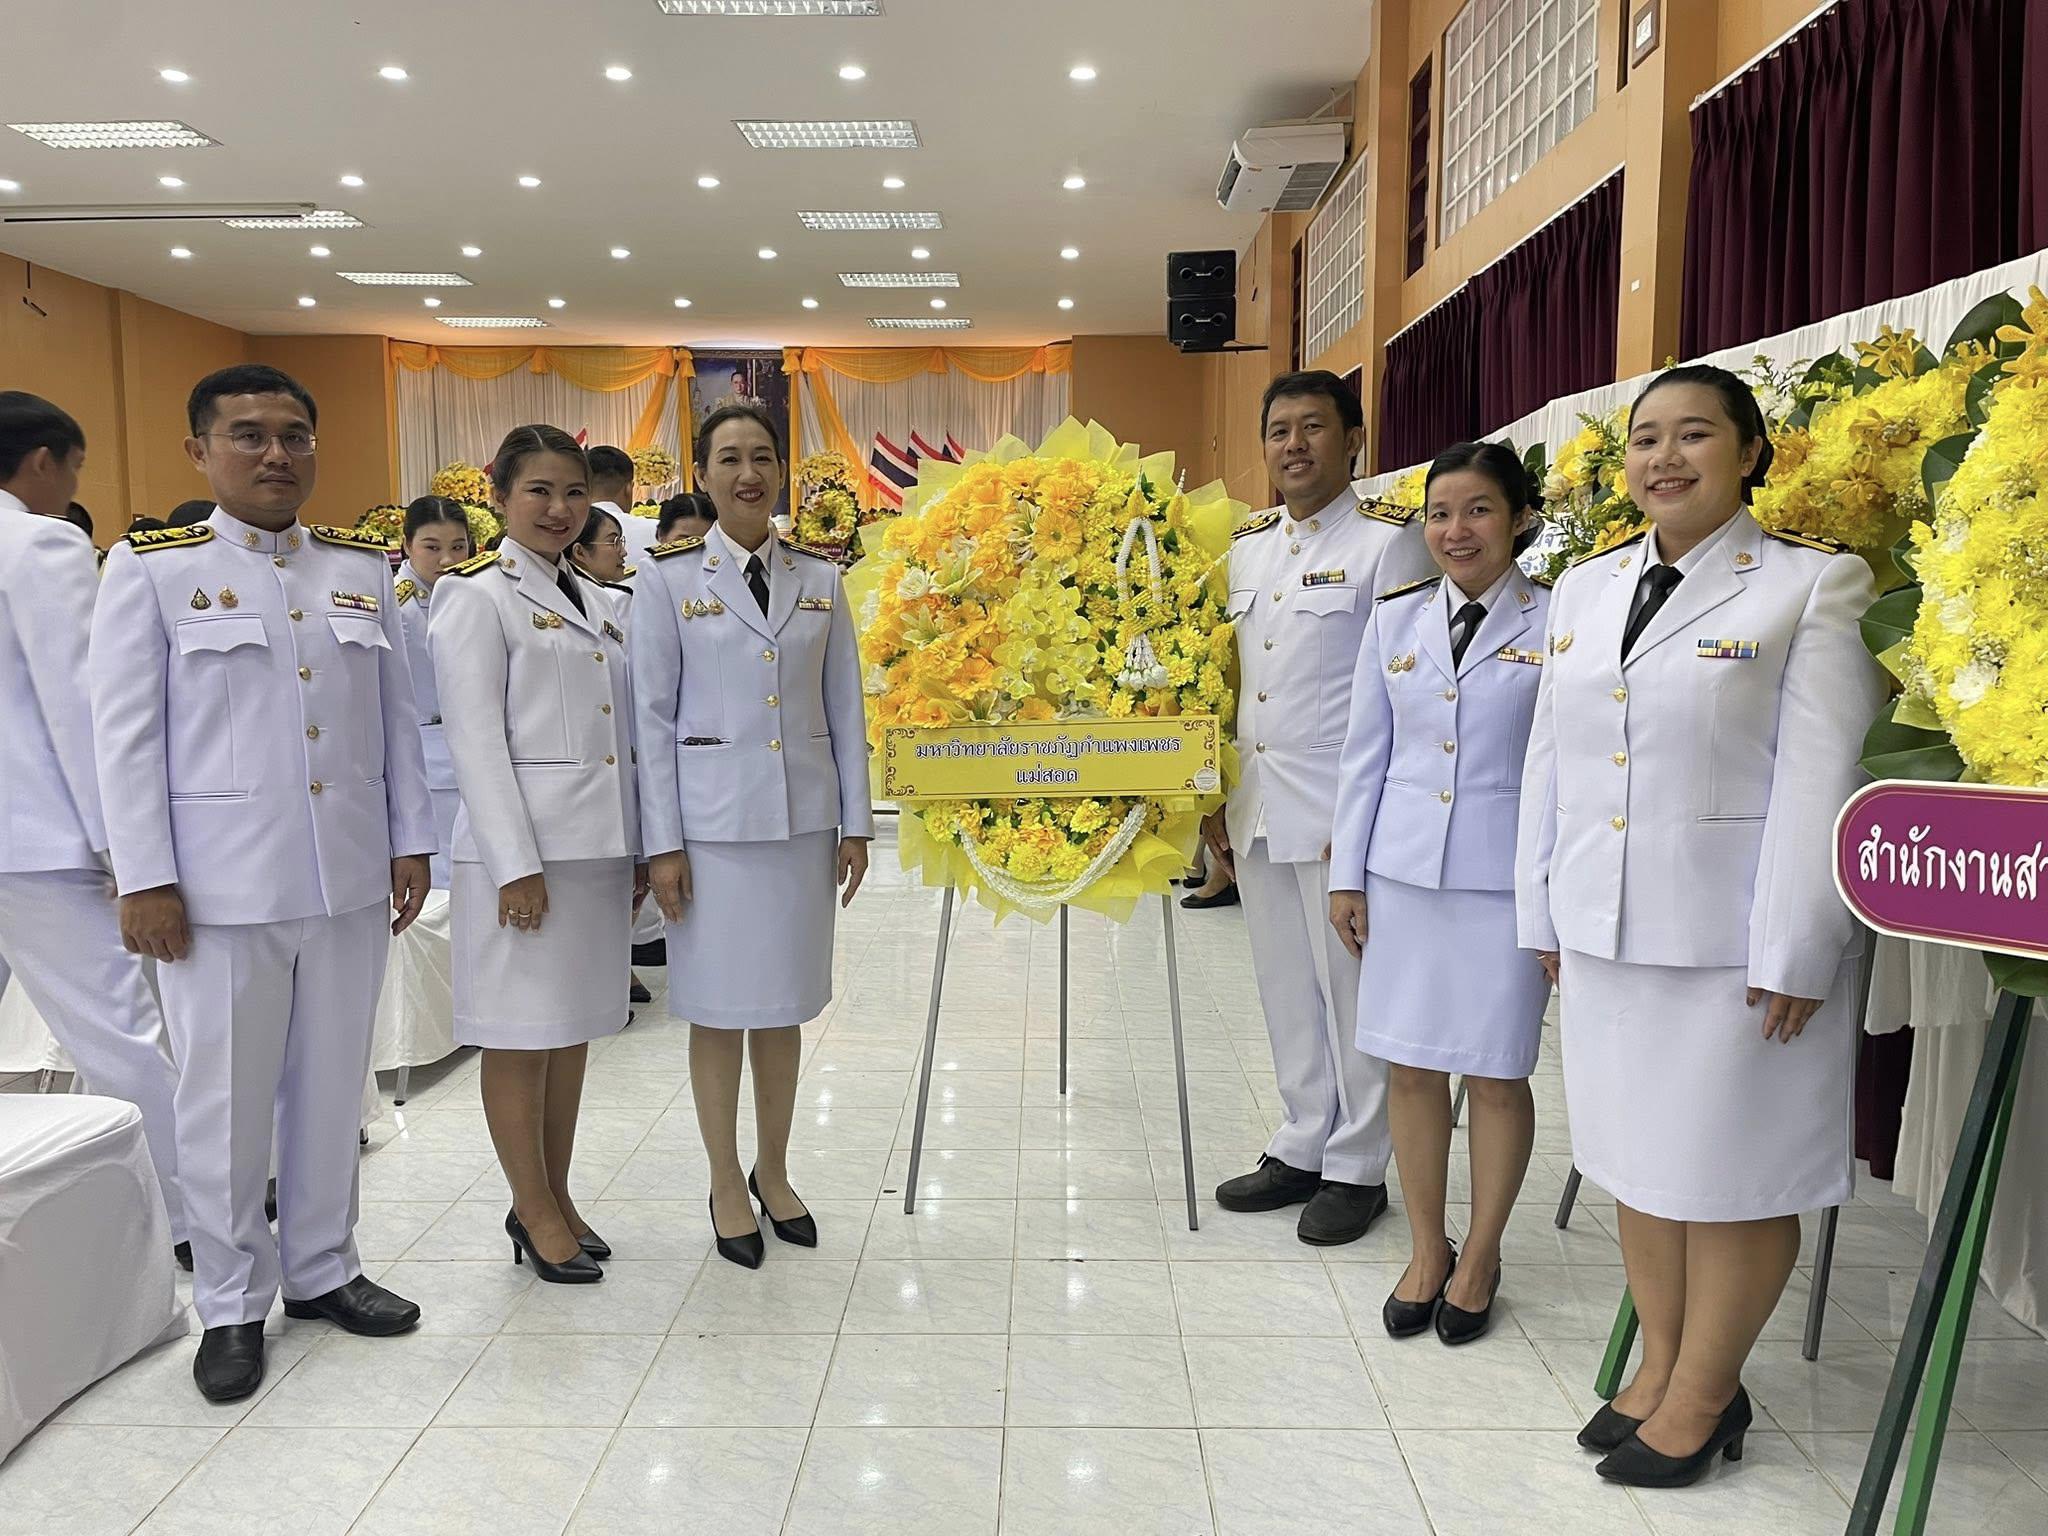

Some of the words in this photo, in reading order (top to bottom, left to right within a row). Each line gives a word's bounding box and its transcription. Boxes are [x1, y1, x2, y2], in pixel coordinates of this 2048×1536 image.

[915, 735, 1182, 759] มหาวิทยาลัยราชภัฏกำแพงเพชร
[1015, 762, 1079, 784] แม่สอด
